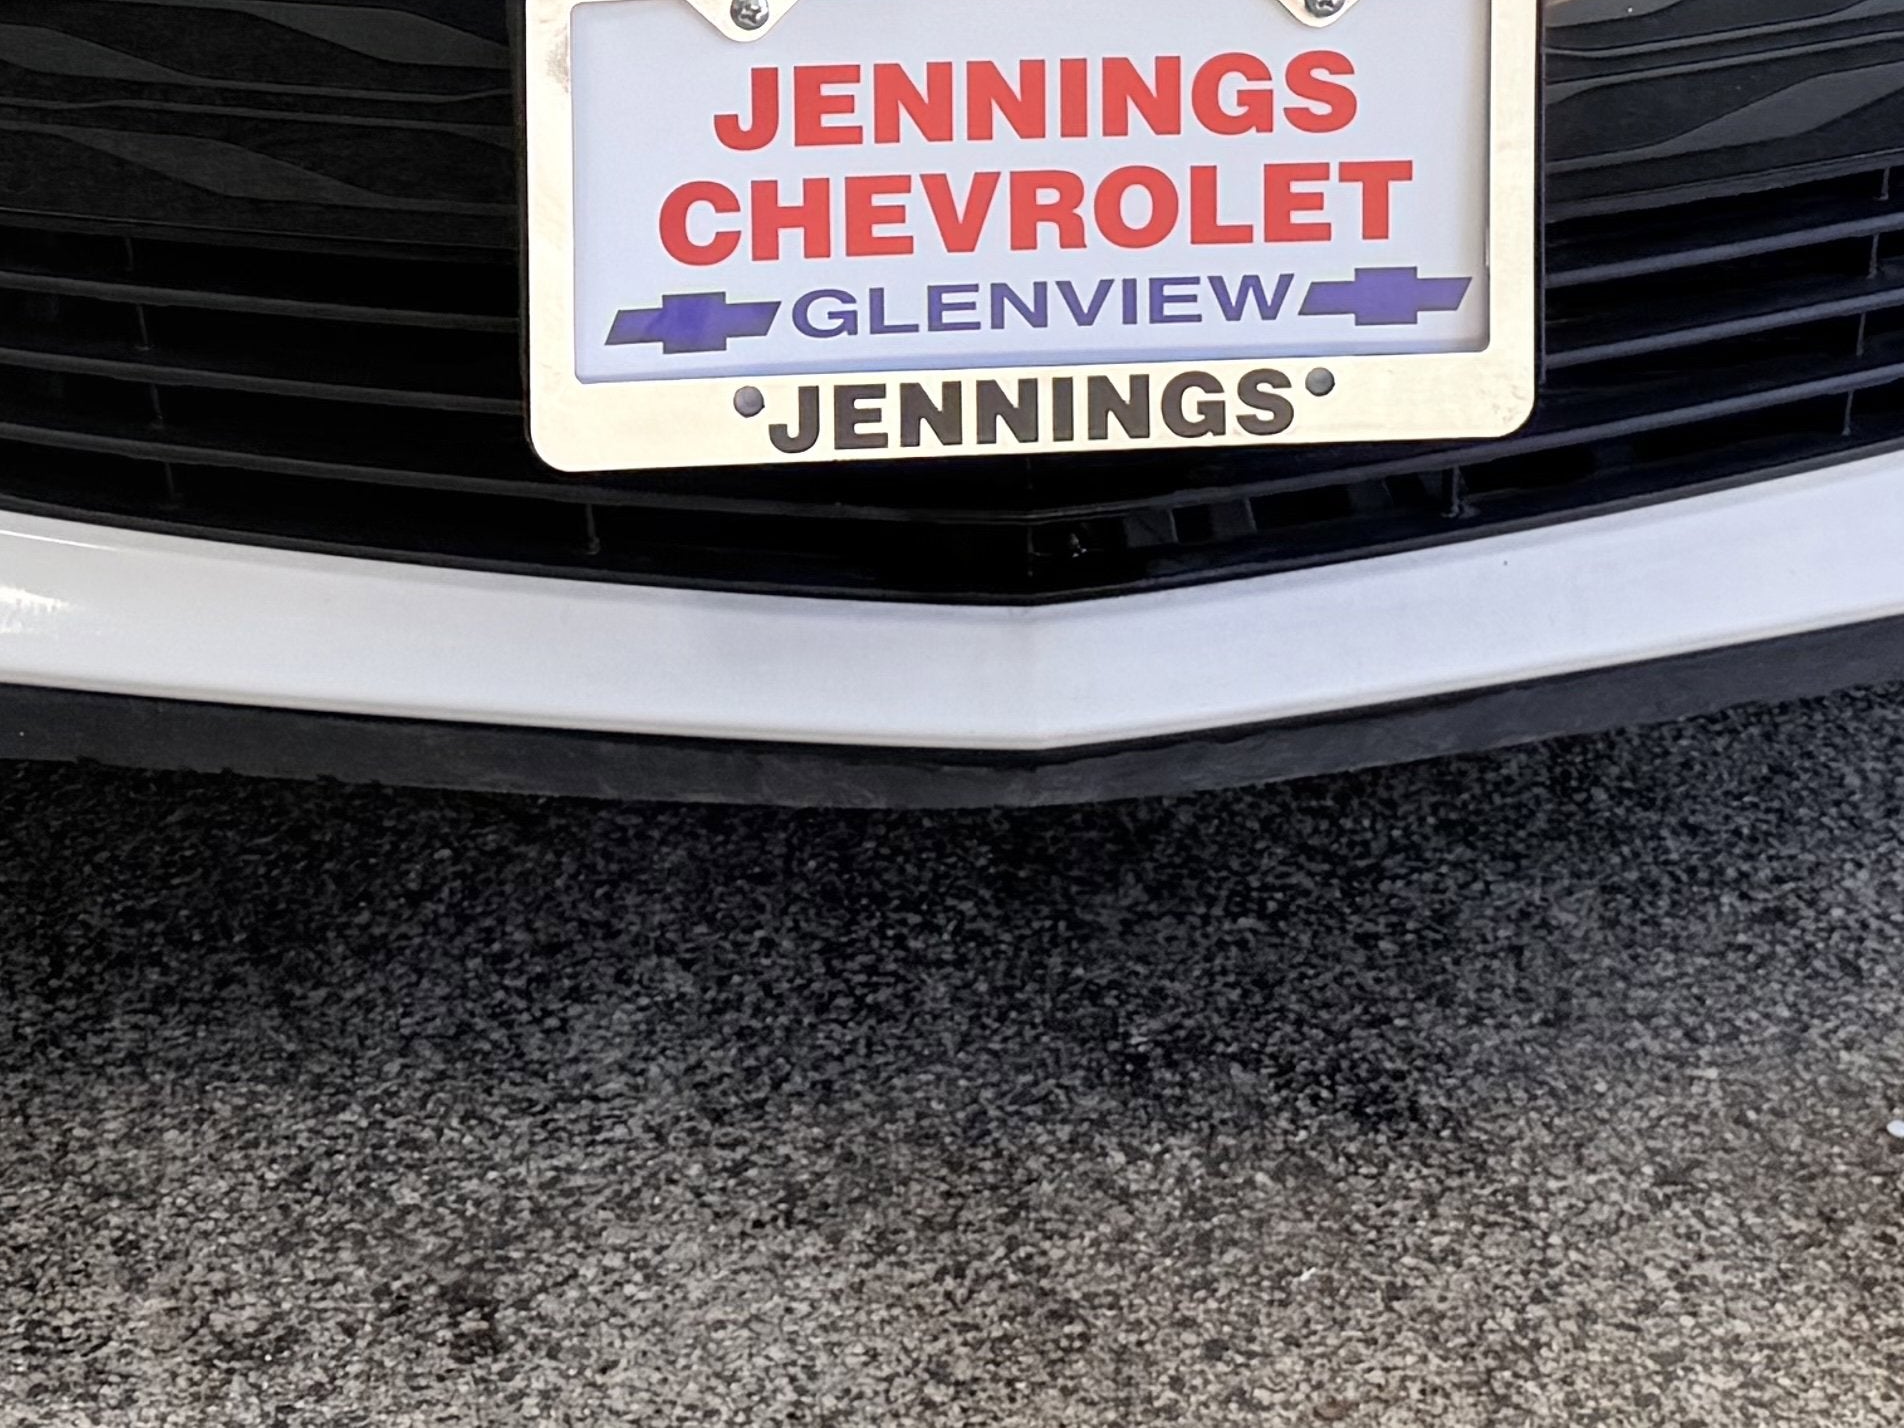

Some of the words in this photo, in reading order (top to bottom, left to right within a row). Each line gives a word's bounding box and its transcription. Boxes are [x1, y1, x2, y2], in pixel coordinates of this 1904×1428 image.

[713, 49, 1359, 152] JENNINGS
[658, 159, 1414, 267] CHEVROLET
[790, 272, 1296, 340] GLENVIEW
[767, 368, 1296, 455] JENNINGS
